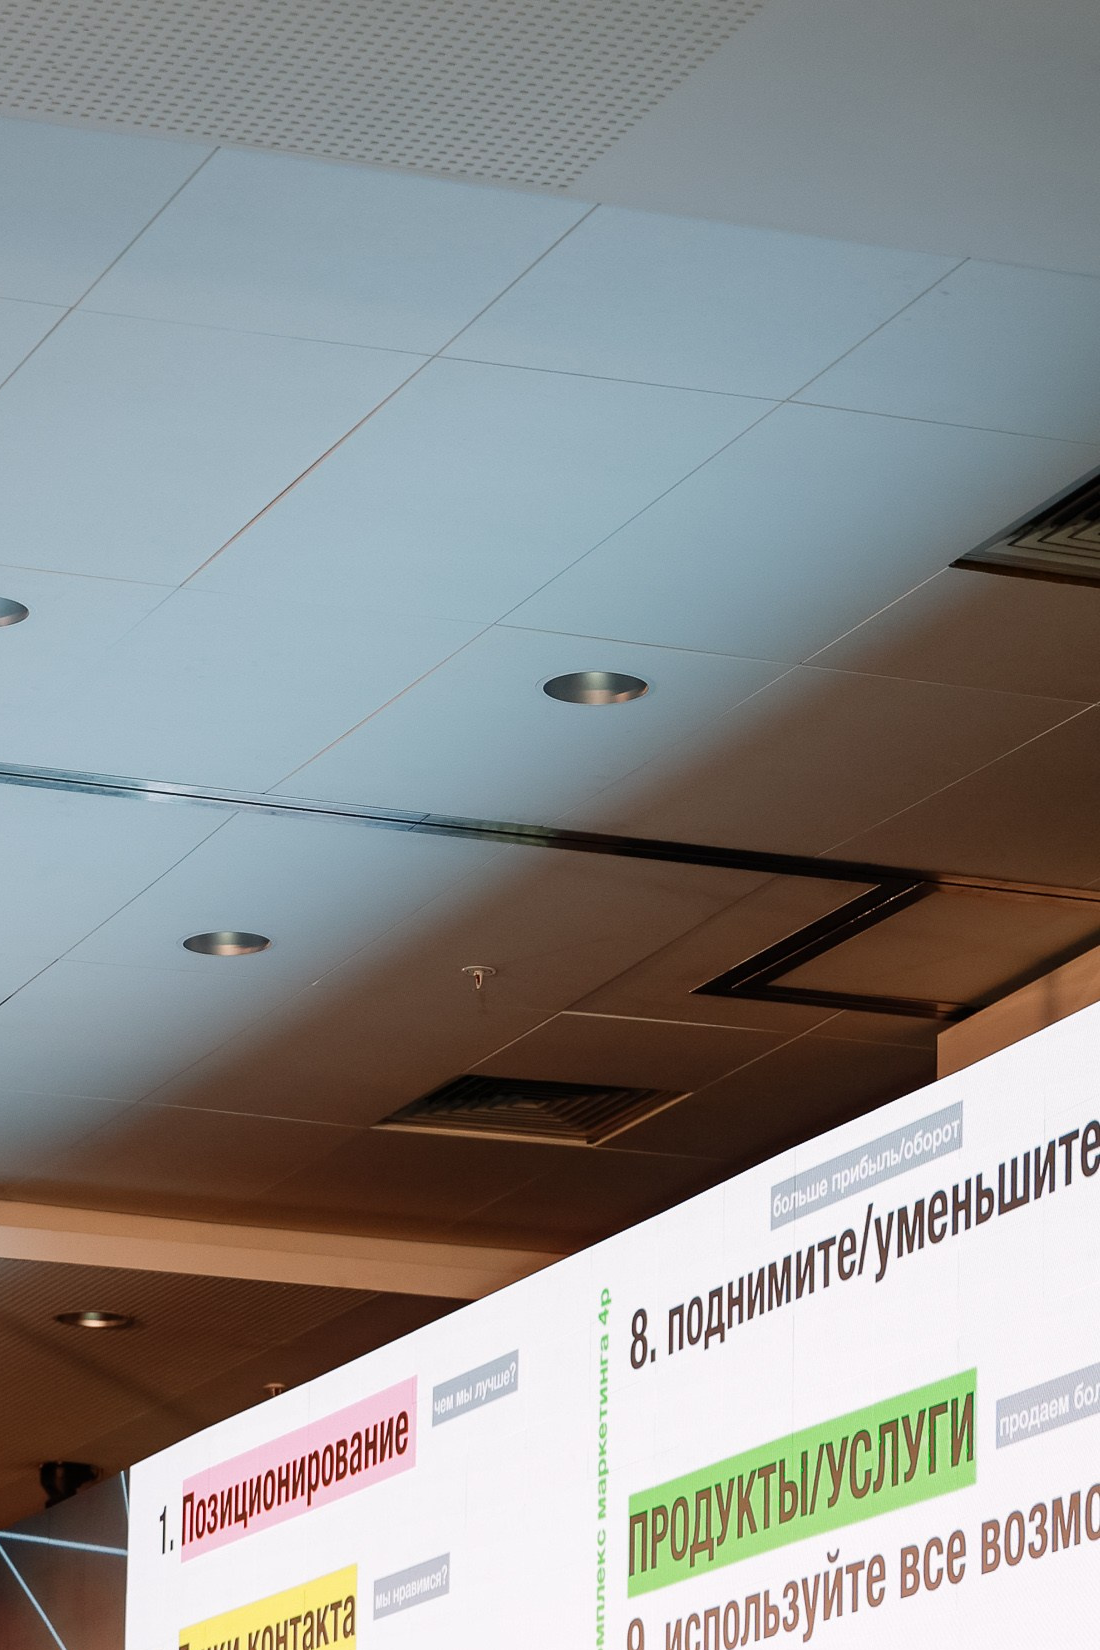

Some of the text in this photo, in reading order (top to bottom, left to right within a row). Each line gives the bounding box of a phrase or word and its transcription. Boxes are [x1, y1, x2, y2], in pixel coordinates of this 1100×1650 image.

[773, 1118, 961, 1218] больше прибыль/оборот
[630, 1119, 1100, 1370] 8. поднимите/уменьшите
[434, 1361, 517, 1415] чем мы лучше?
[598, 1336, 610, 1520] маркетинга
[1000, 1396, 1069, 1438] продаем
[159, 1410, 410, 1555] 1. Позиционирование
[629, 1391, 975, 1578] ПРОДУКТЫ/УСЛУГИ
[375, 1564, 448, 1610] мы нравимся?
[900, 1530, 966, 1599] все
